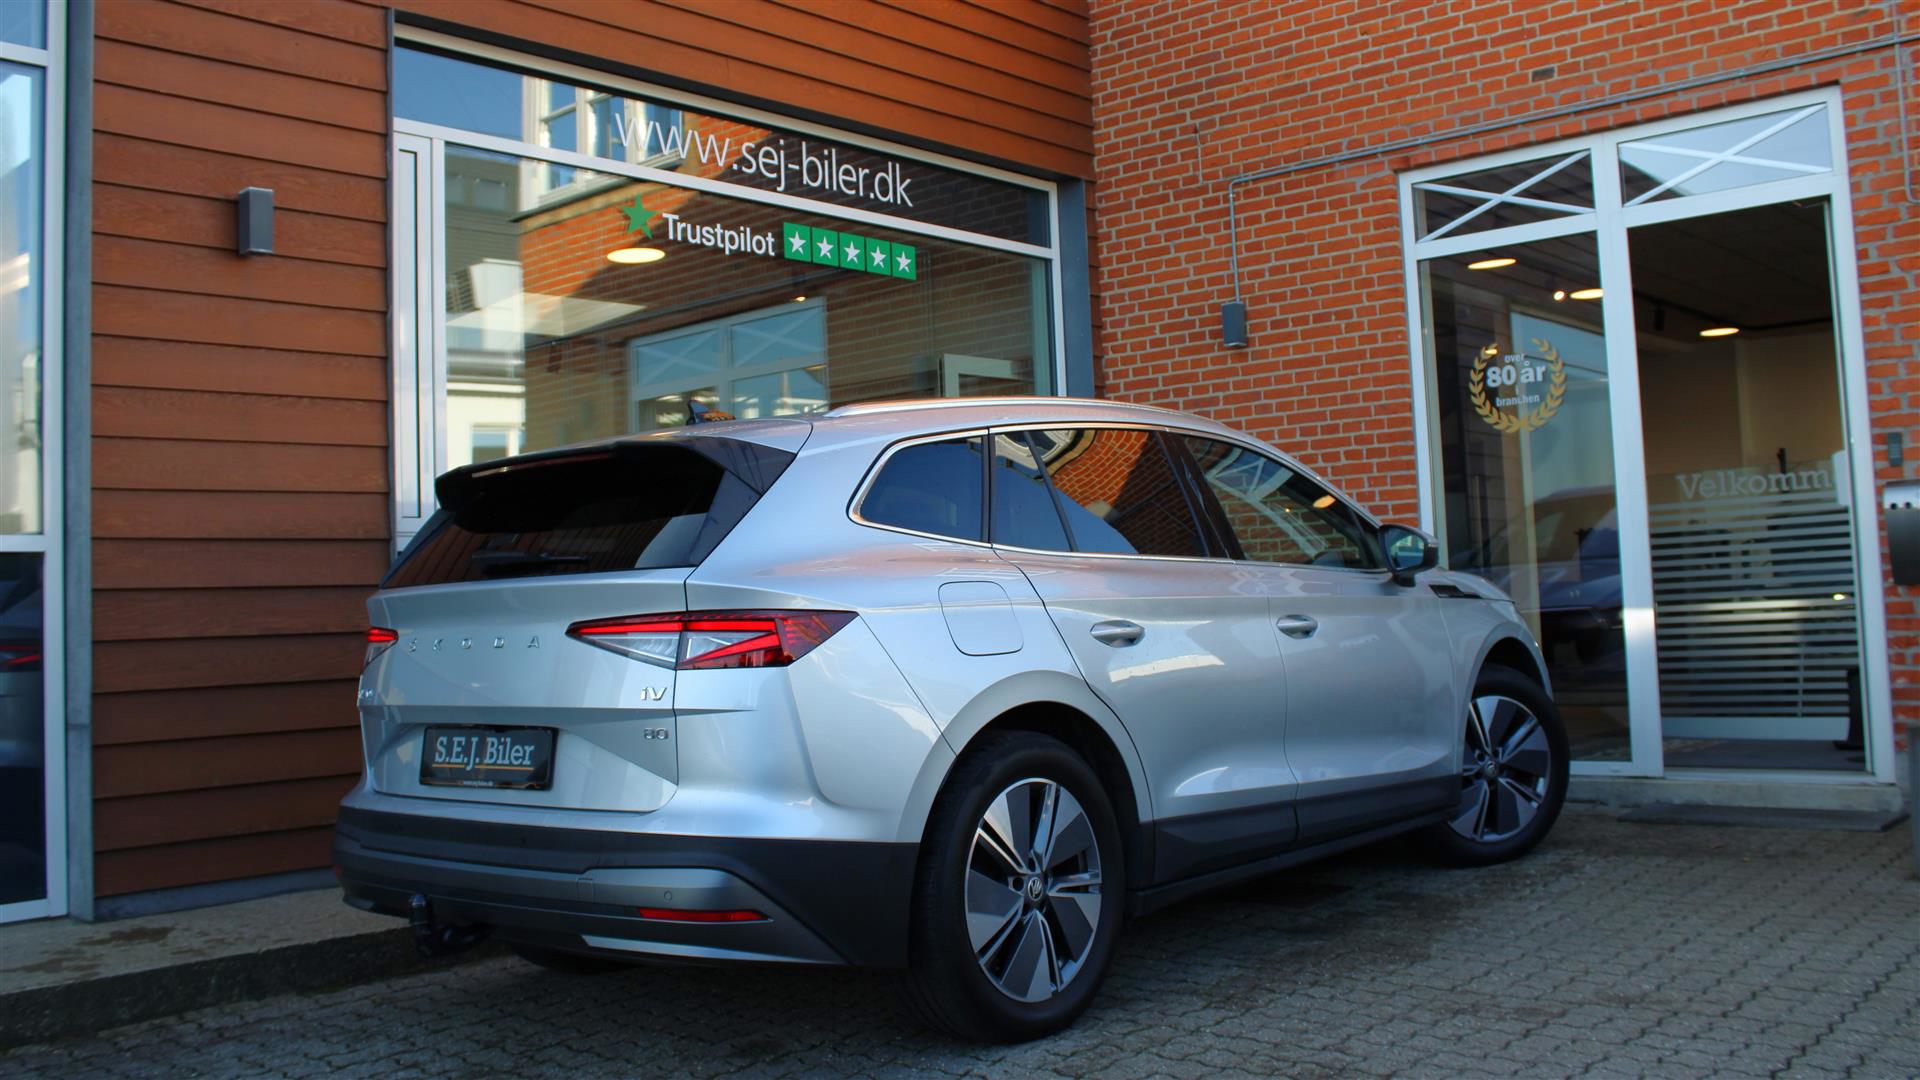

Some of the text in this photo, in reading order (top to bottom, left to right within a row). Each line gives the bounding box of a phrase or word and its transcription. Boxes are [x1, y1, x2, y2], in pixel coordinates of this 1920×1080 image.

[615, 112, 913, 207] www.sej-biler.dk
[662, 213, 775, 257] Trustpilot
[1486, 361, 1546, 387] 80 år
[1676, 469, 1832, 498] Velkomm
[644, 727, 669, 740] 80
[434, 736, 535, 771] S.E.J. Biler
